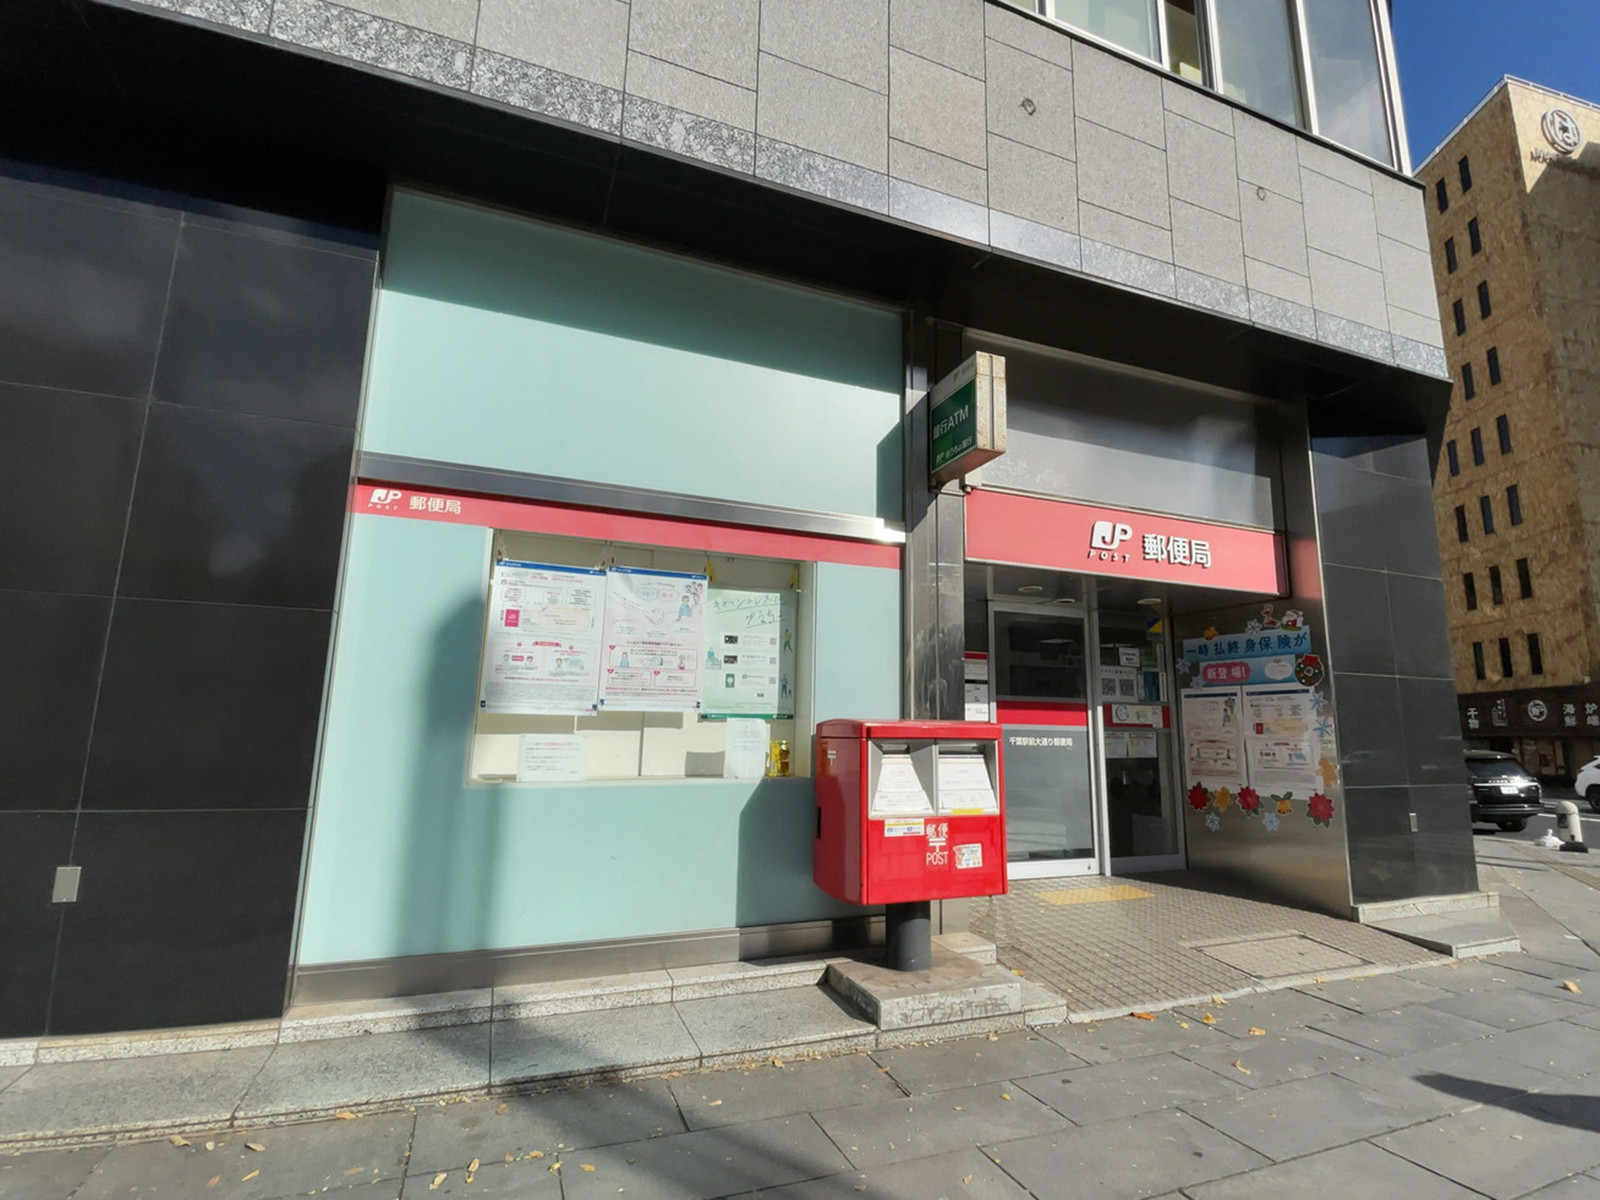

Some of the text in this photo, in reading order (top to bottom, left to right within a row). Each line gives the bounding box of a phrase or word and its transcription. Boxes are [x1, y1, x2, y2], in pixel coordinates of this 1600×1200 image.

[369, 488, 462, 515] JP 郵便局
[1091, 520, 1212, 568] JP 郵便局
[1088, 550, 1131, 563] POST
[926, 822, 949, 839] 郵便
[926, 851, 949, 866] POST
